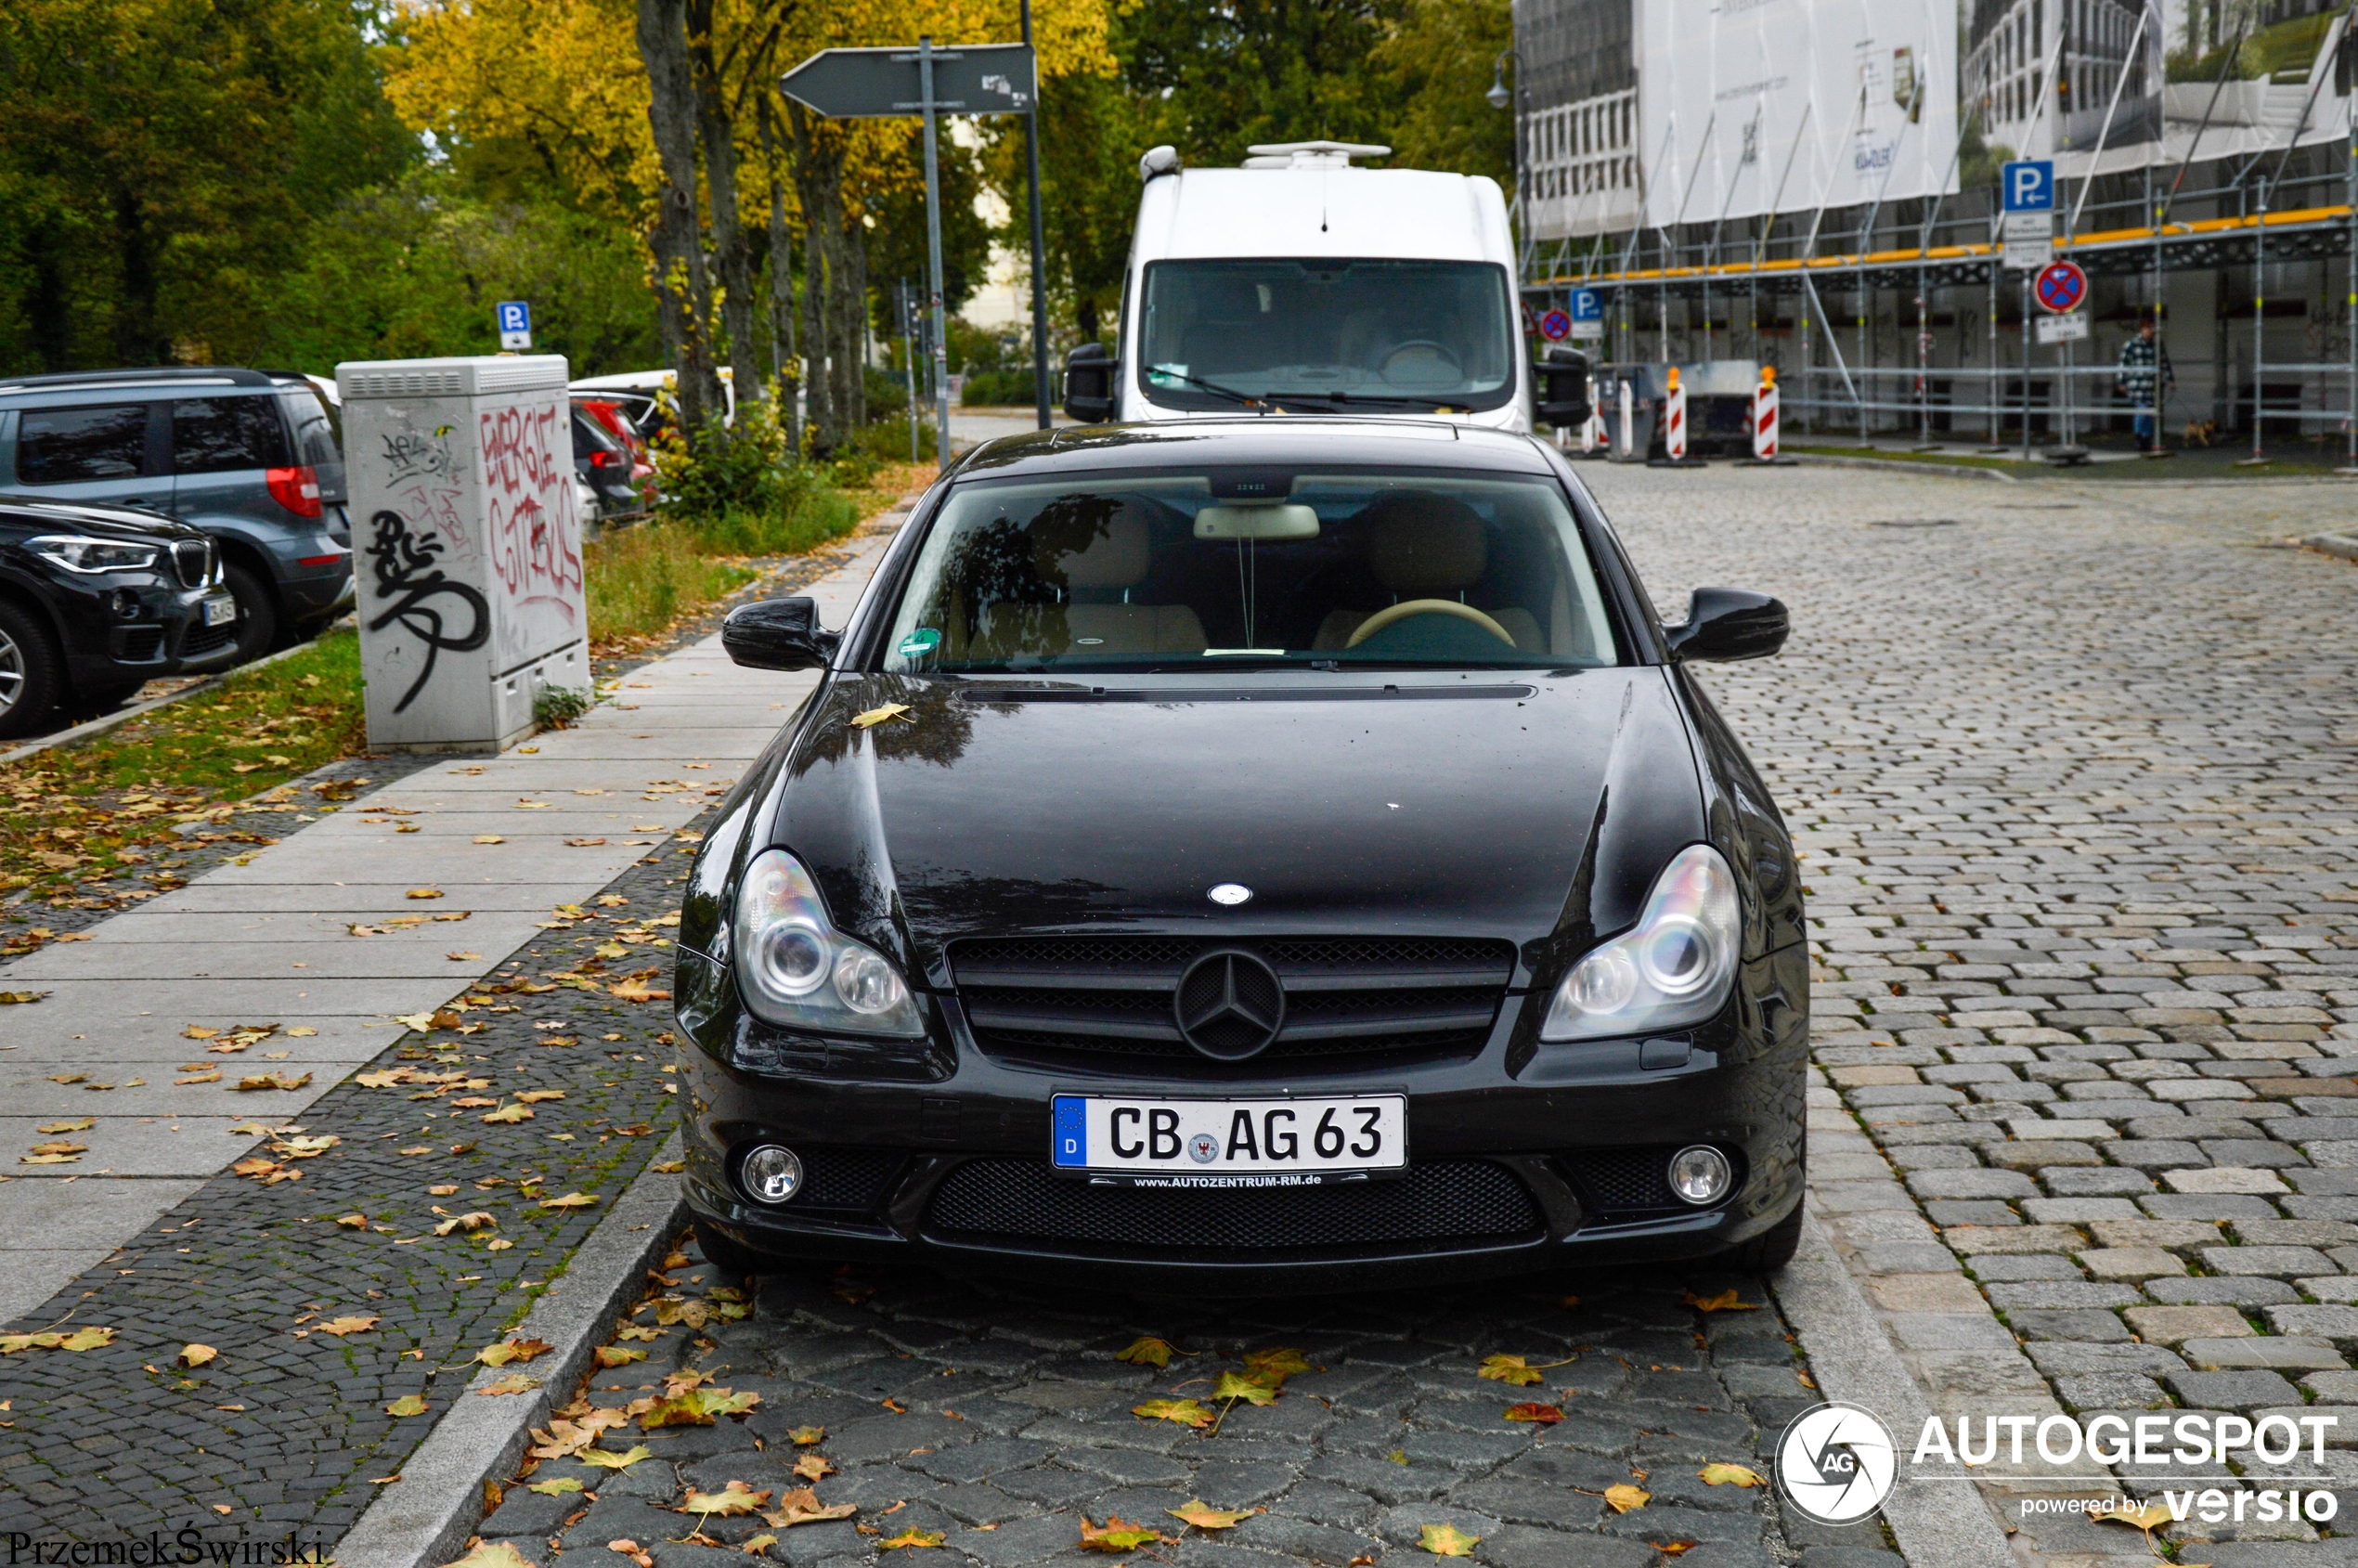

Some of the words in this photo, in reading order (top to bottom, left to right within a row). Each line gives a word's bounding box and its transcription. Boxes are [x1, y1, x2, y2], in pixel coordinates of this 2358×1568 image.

[2015, 167, 2042, 206] P
[1578, 292, 1596, 317] P
[504, 305, 523, 330] P
[1065, 1138, 1077, 1154] D
[1110, 1107, 1183, 1160] CB
[1224, 1108, 1298, 1160] AG
[1313, 1107, 1381, 1160] 63
[1134, 1174, 1322, 1188] www.AUTOZENTRUM-RM.de
